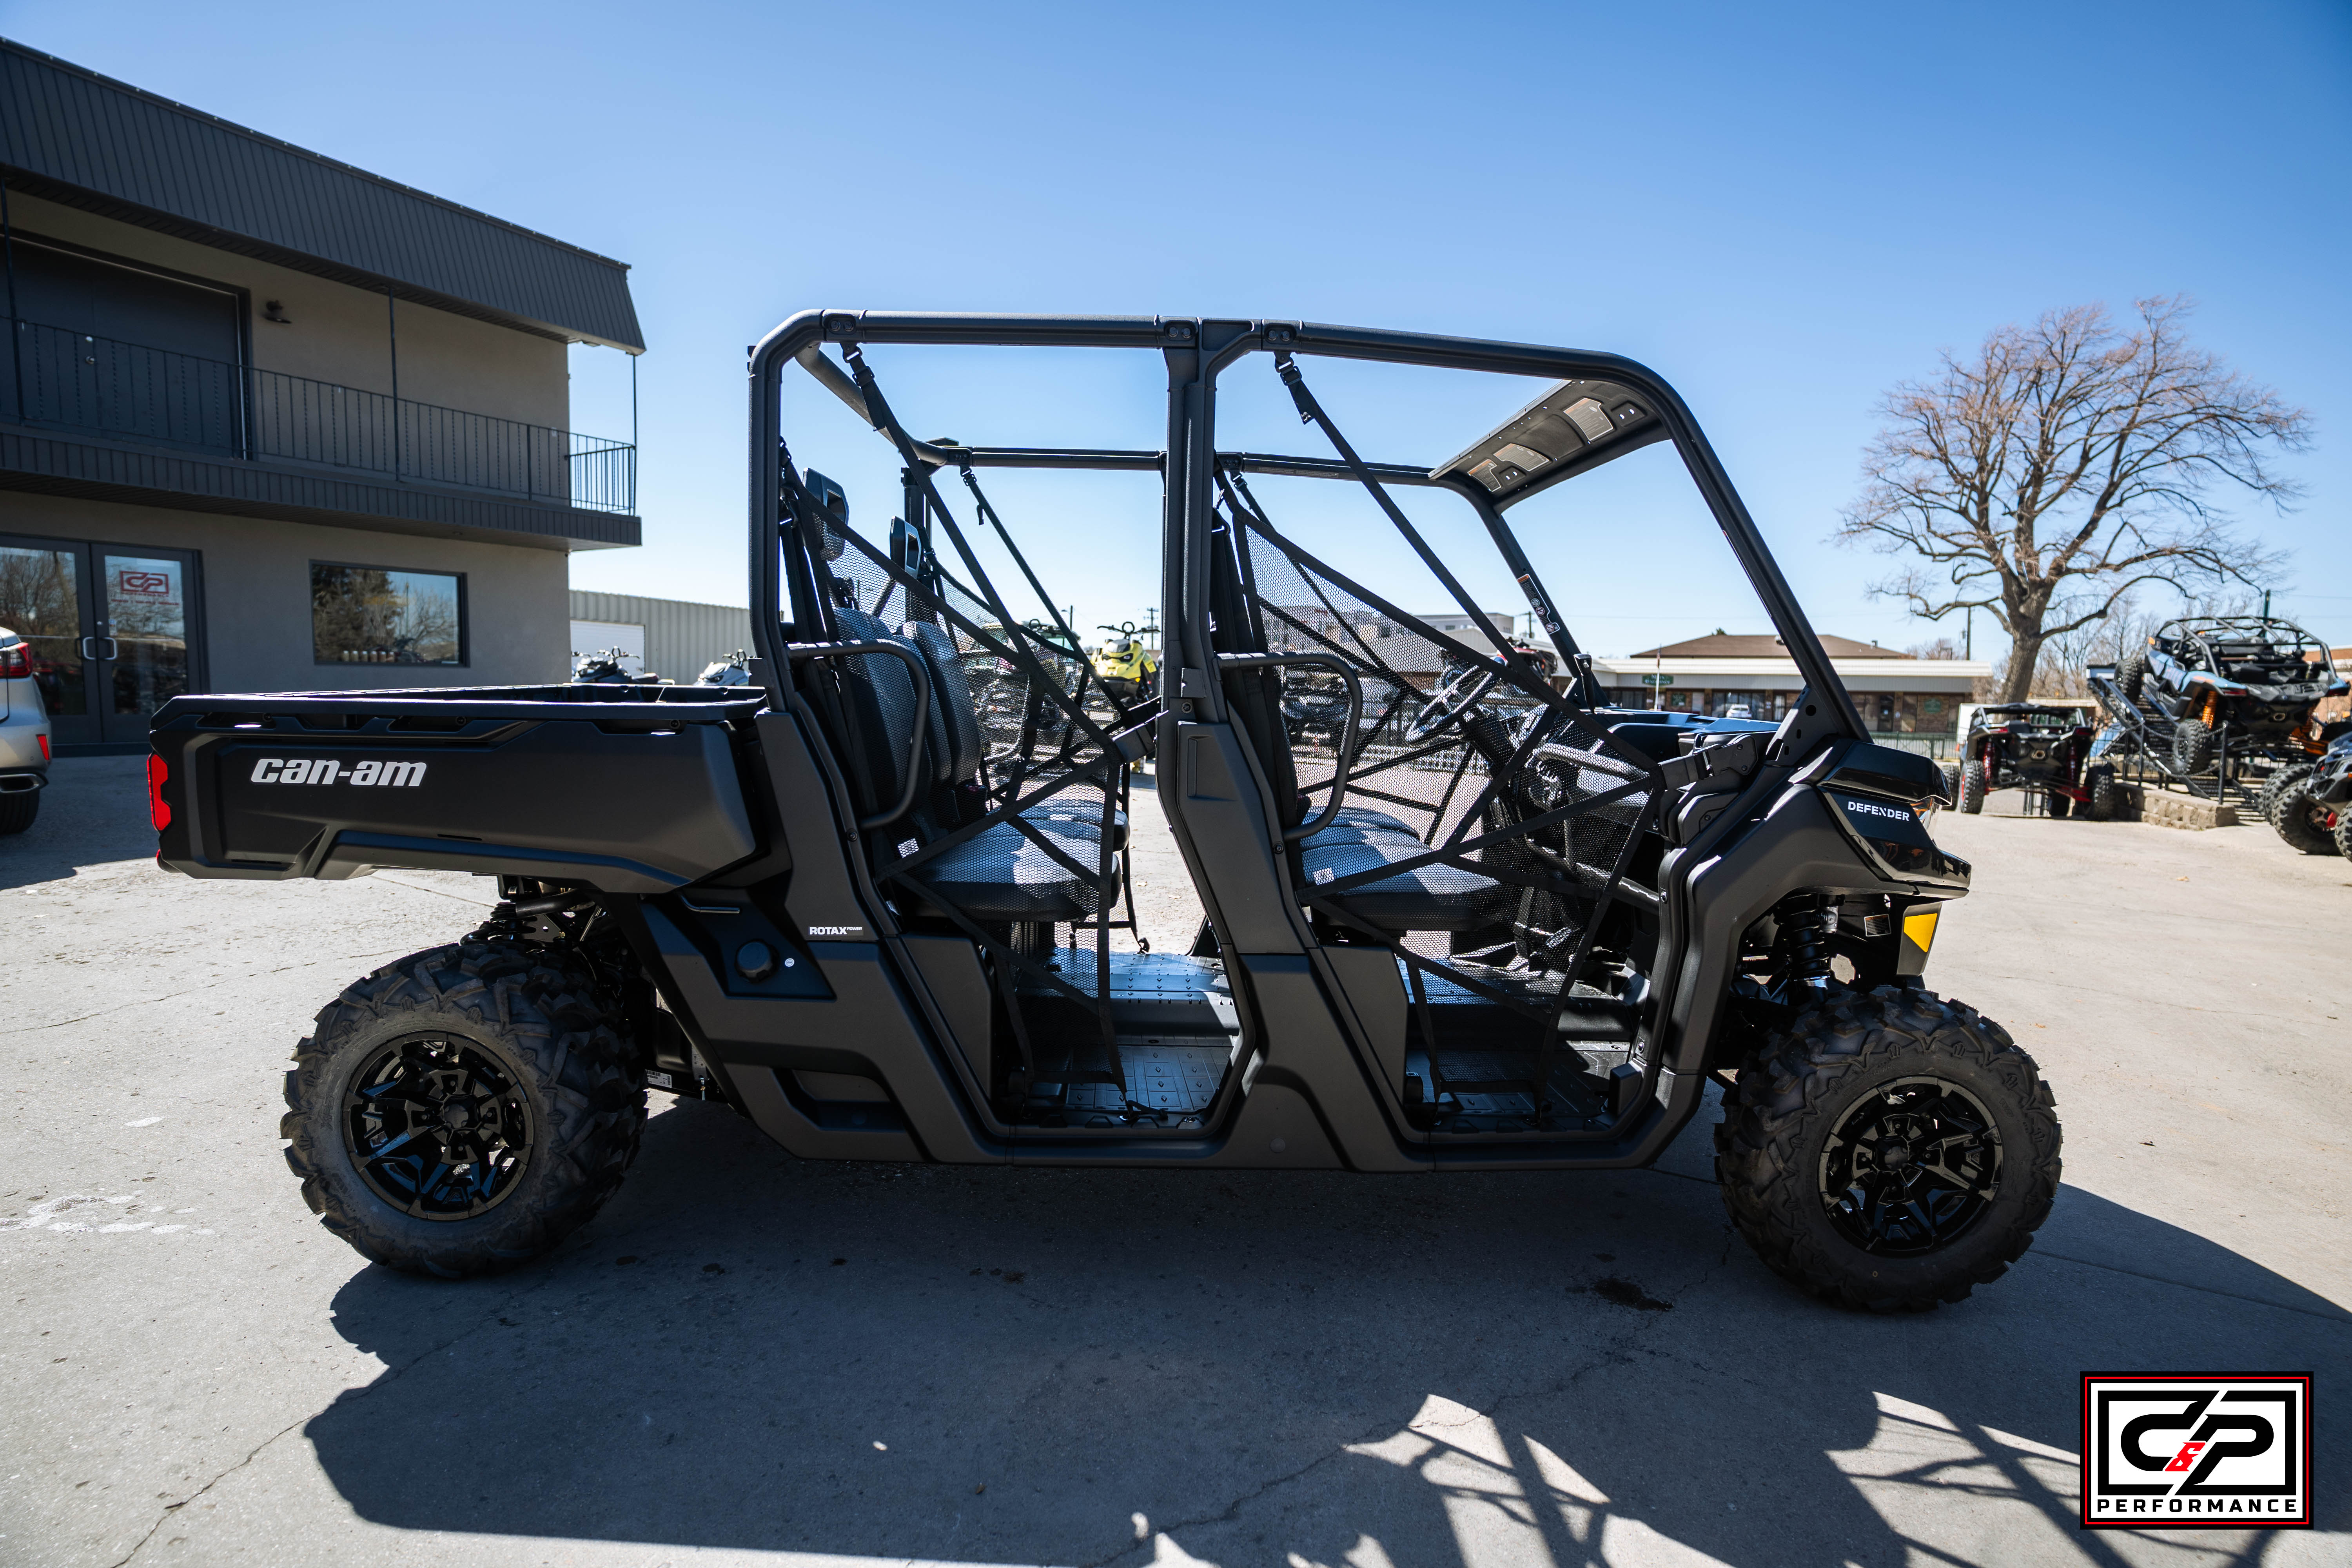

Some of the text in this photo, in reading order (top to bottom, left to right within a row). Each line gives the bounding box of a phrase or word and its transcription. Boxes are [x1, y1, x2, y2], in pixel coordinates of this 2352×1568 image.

[251, 759, 427, 786] can-am
[1847, 801, 1910, 821] DEFENDER
[809, 927, 847, 935] ROTAX
